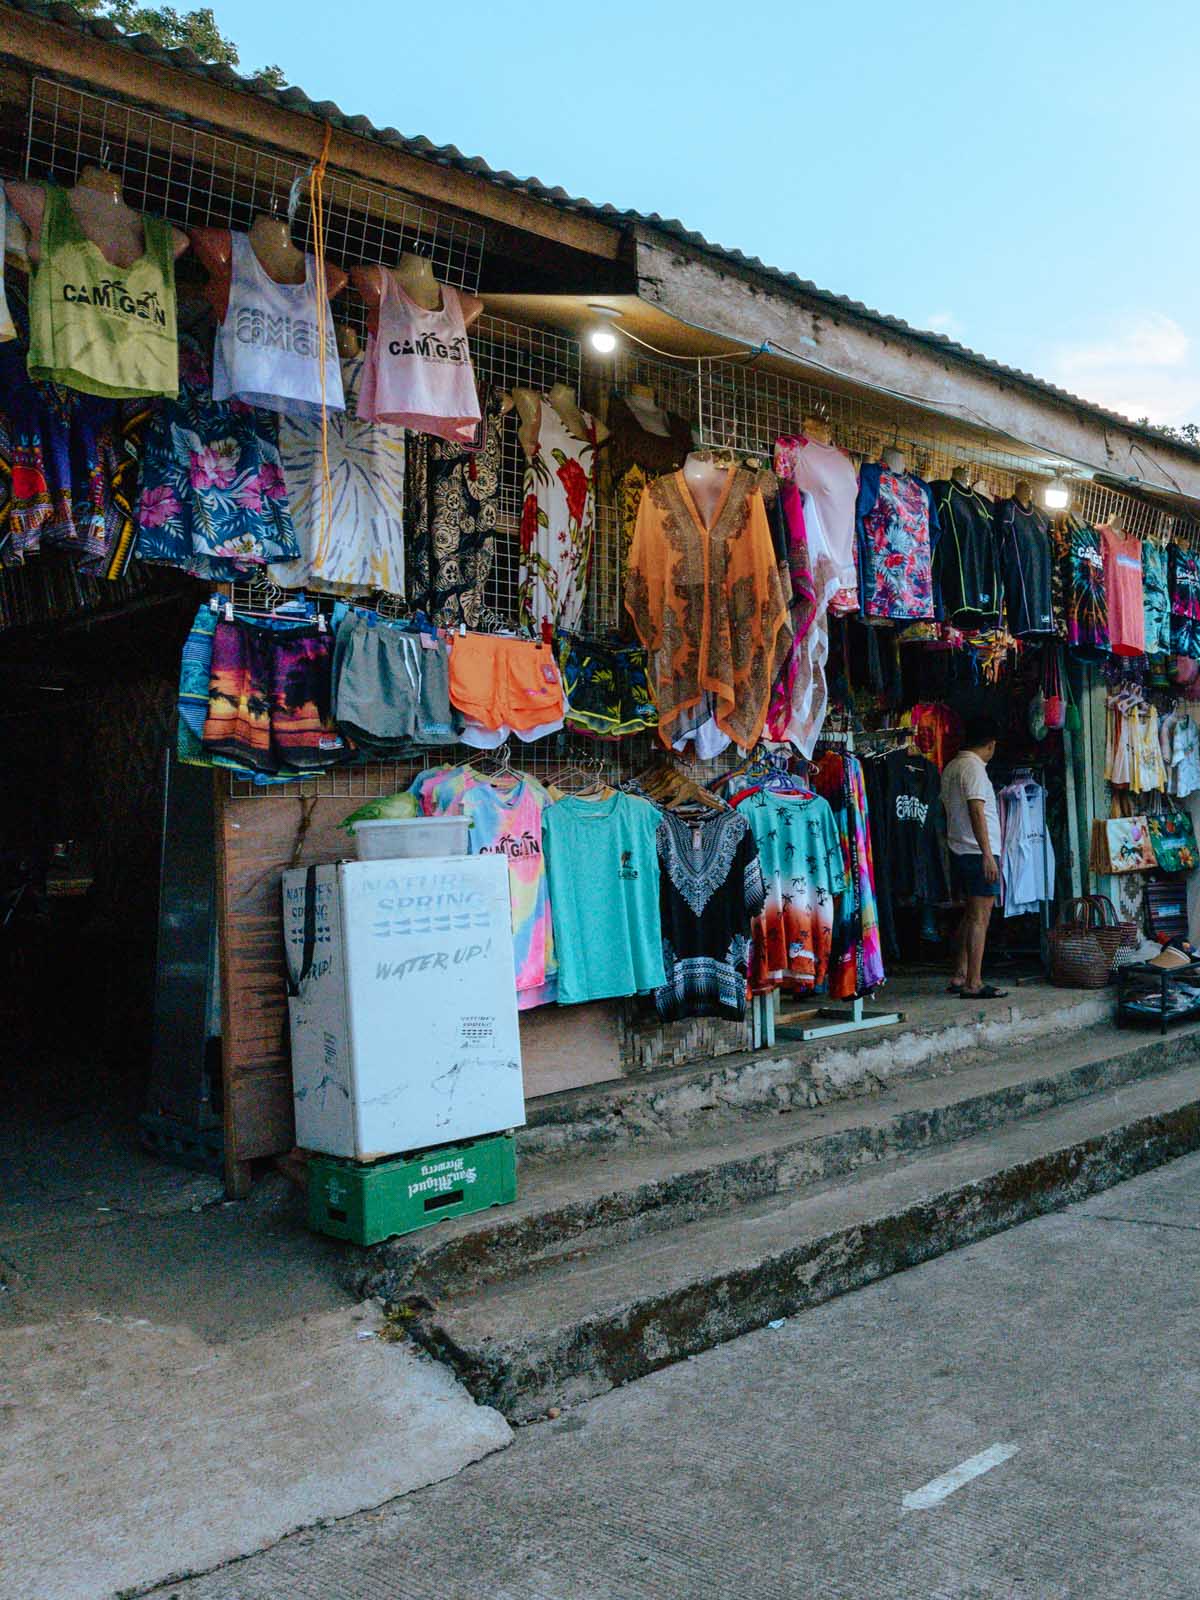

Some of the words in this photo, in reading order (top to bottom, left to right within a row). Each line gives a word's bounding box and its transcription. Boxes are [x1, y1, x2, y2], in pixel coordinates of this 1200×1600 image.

[236, 324, 337, 359] CAMIGUN
[286, 883, 333, 900] NATE'S
[292, 903, 329, 918] SPNG
[375, 952, 450, 981] WATER
[453, 937, 492, 965] UP!
[421, 1157, 465, 1176] Brewery
